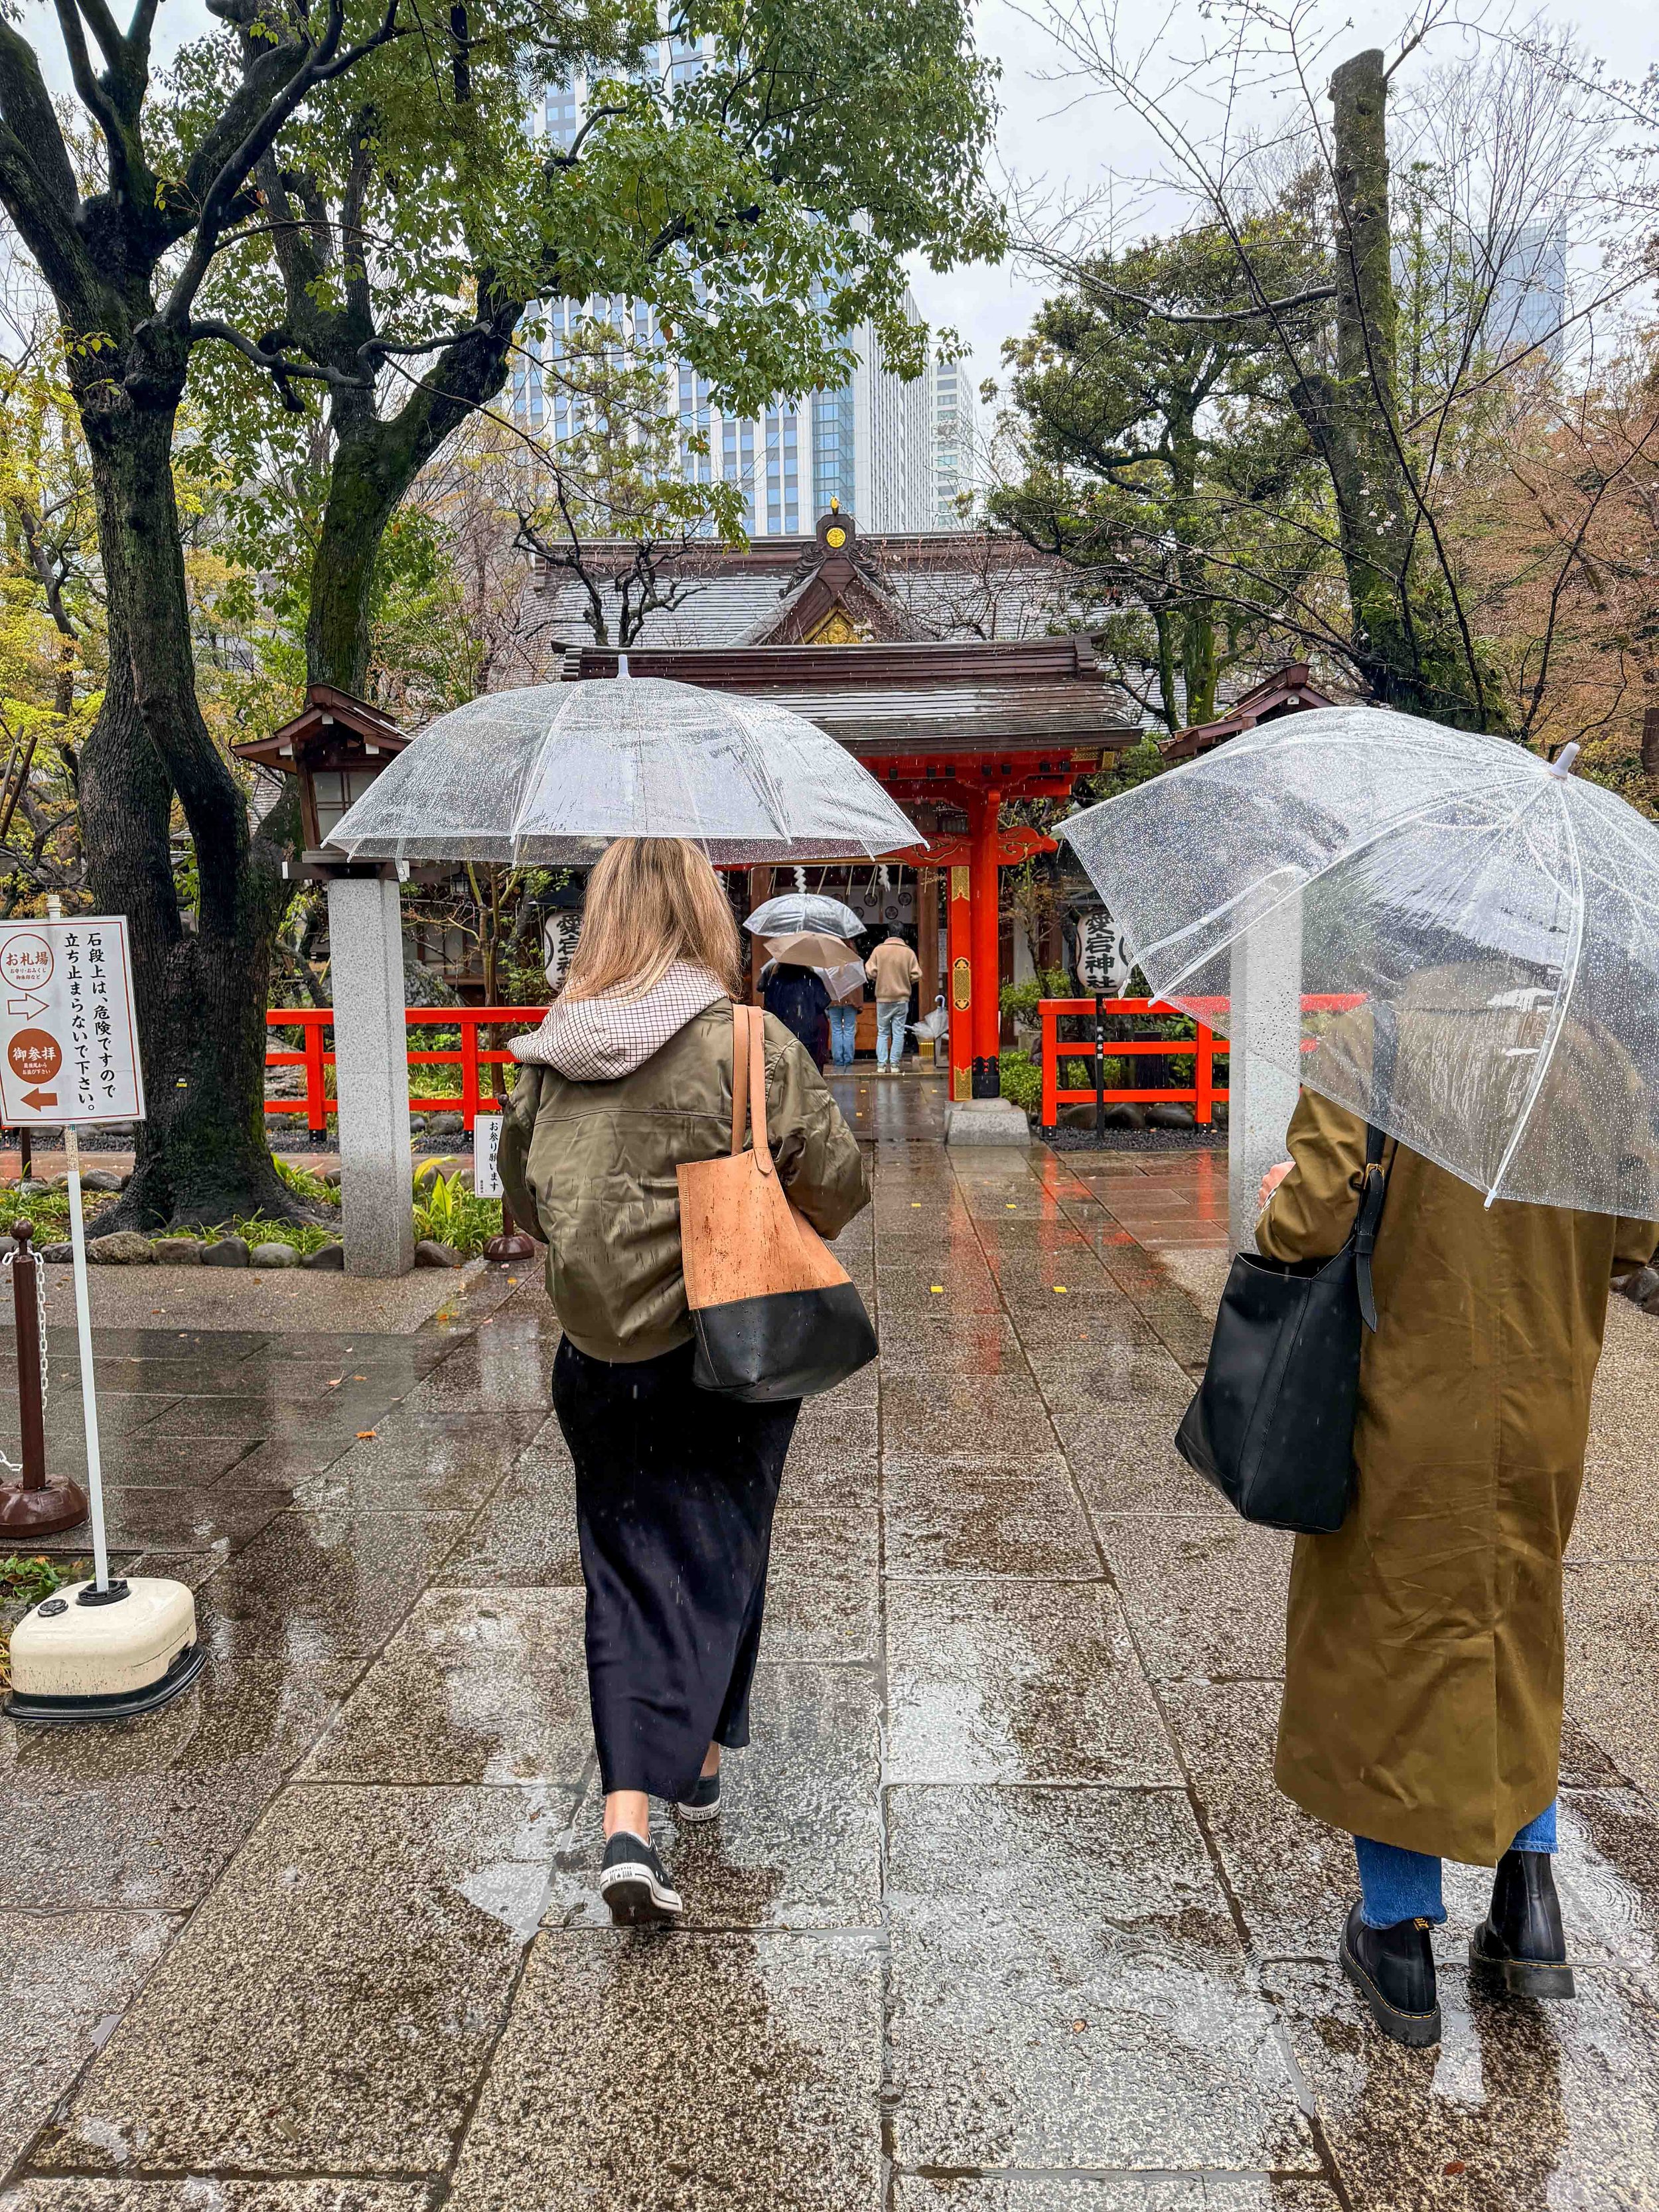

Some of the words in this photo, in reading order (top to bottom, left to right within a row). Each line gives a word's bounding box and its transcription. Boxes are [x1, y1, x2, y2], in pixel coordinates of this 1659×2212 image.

[5, 951, 48, 966] お札場
[1085, 913, 1117, 988] 愛宕神社
[64, 932, 94, 1110] 立ち止まらないで下さい。
[87, 932, 116, 1098] 石段上は、危険ですので
[13, 1046, 56, 1062] 御参拝
